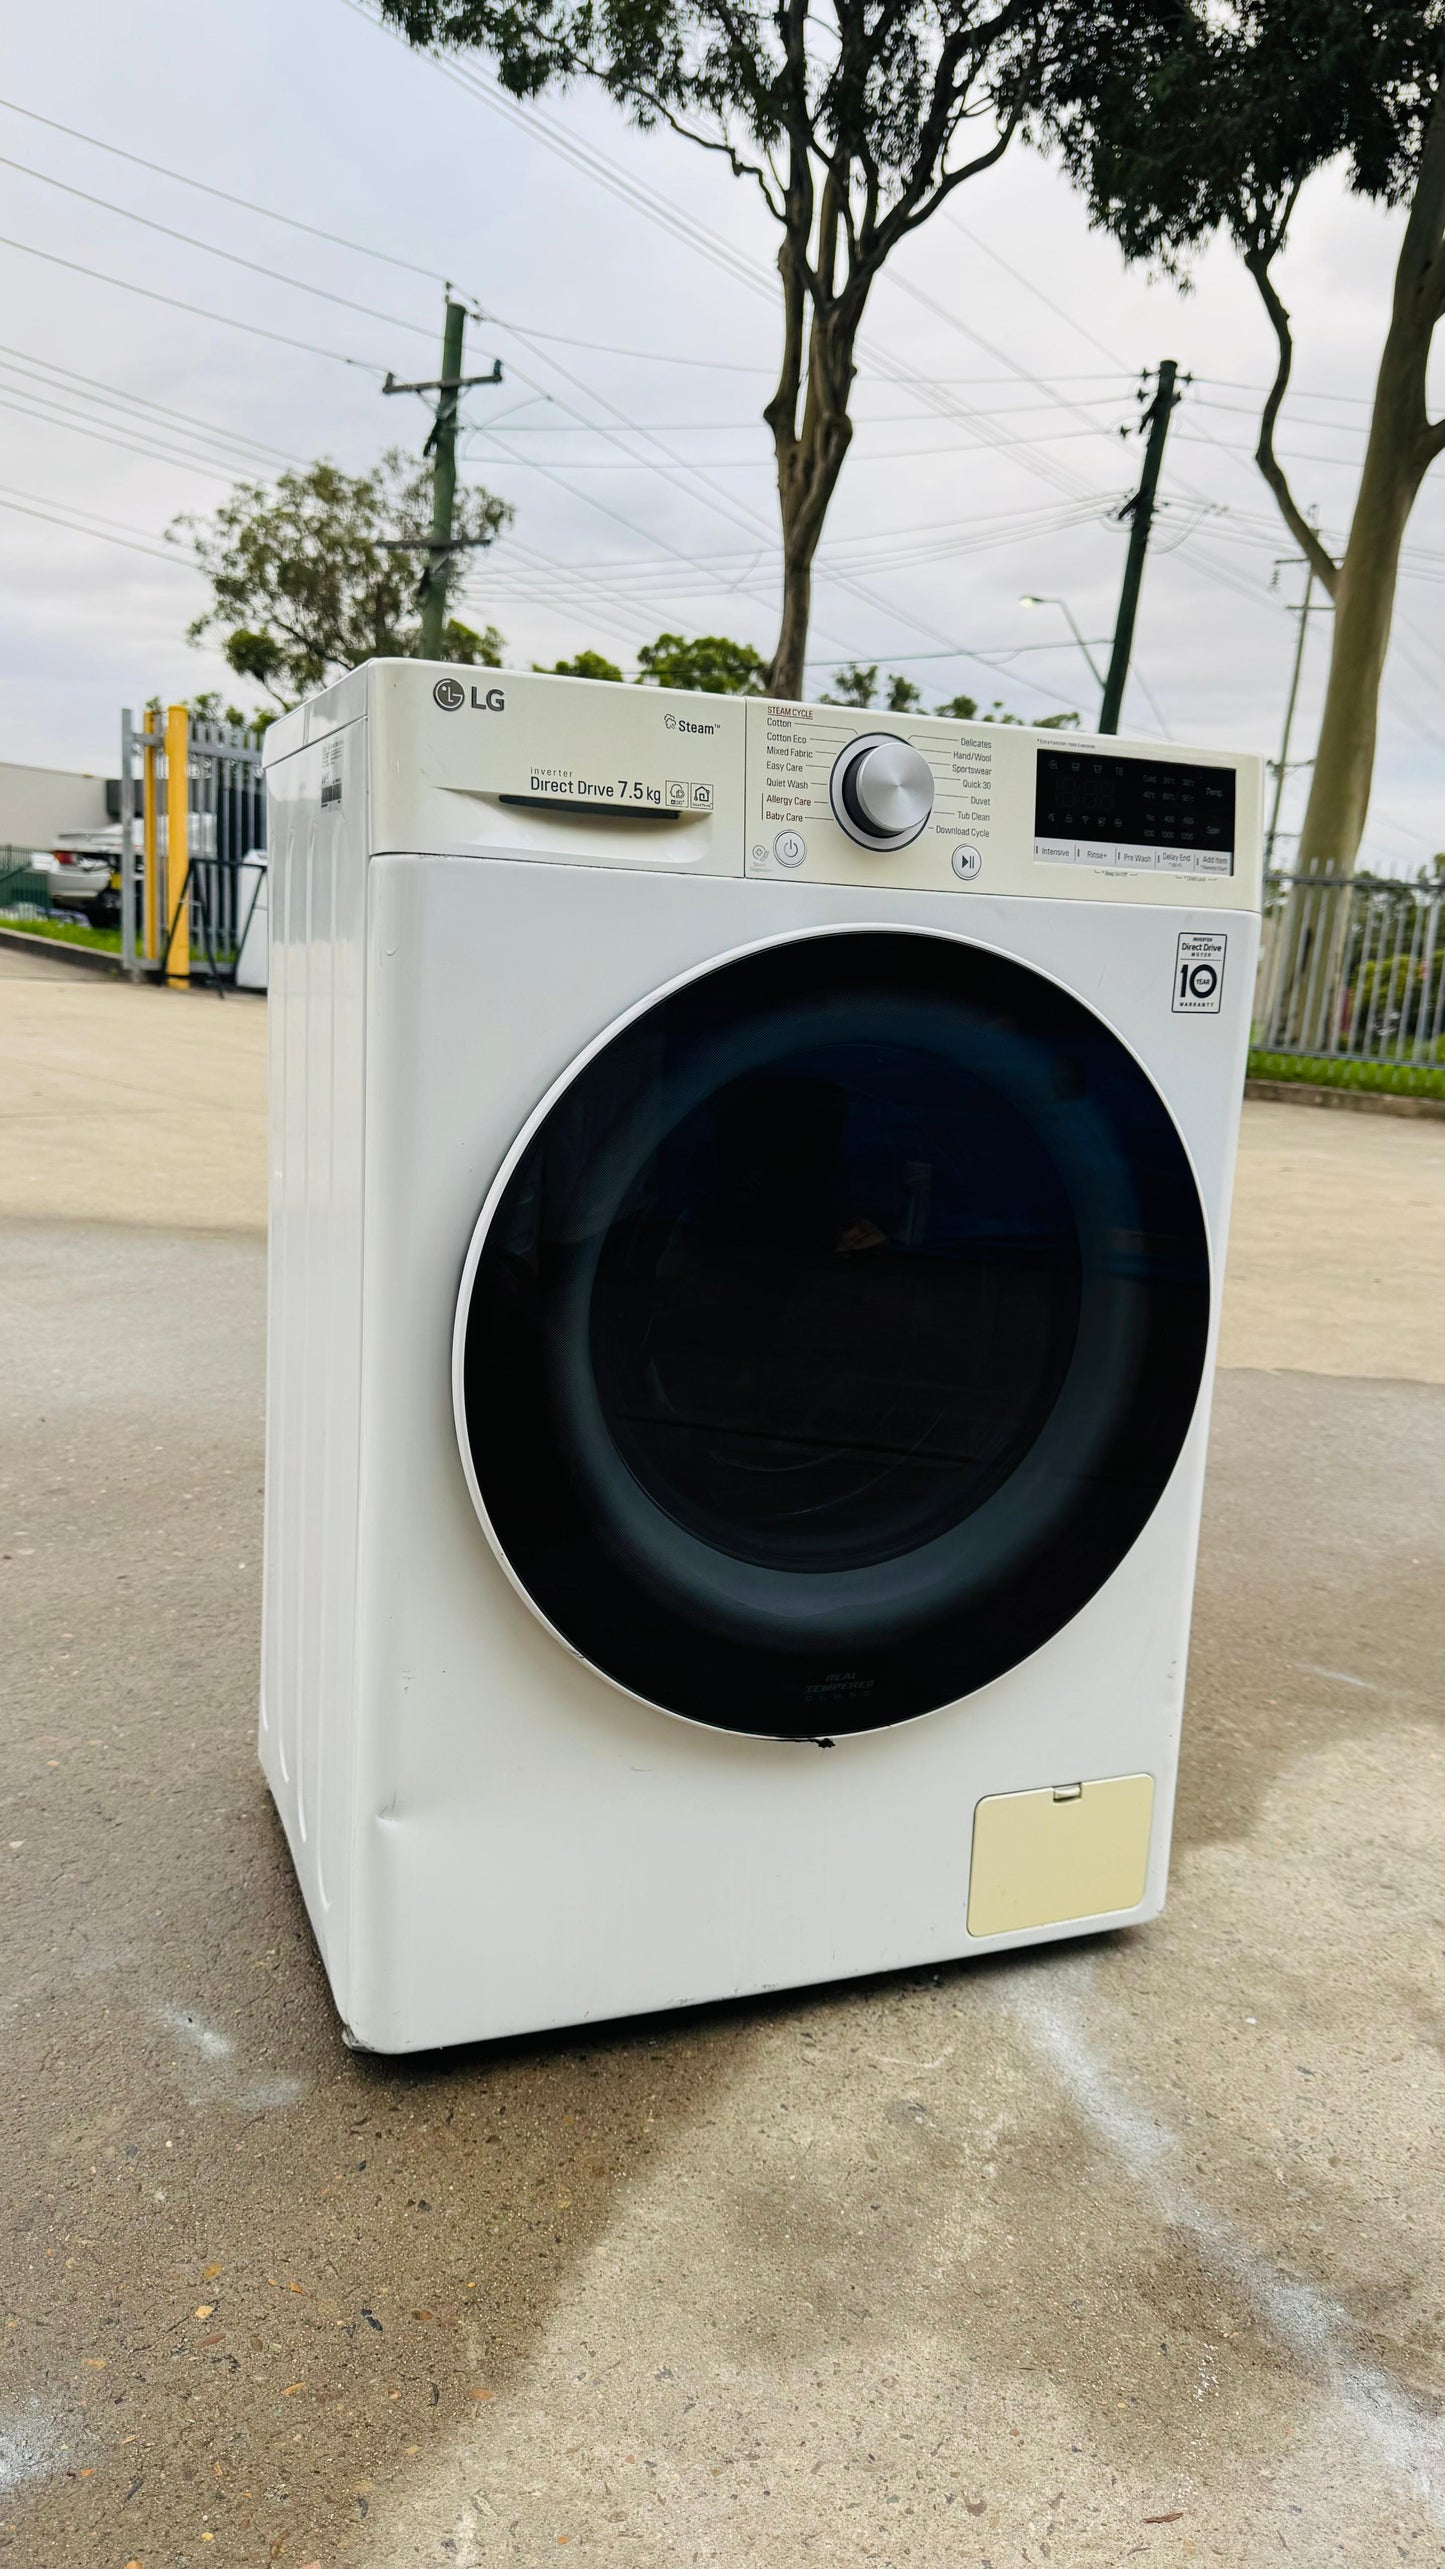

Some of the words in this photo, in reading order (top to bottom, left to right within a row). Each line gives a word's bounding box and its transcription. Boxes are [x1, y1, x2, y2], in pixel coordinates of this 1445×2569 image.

[471, 686, 504, 711] LG
[768, 706, 790, 716] STEAM
[791, 708, 813, 718] CYCLE
[767, 718, 791, 728] Cotton
[767, 733, 791, 742] Cotton
[793, 736, 806, 744] Eco
[961, 738, 991, 748] Delicates
[767, 746, 788, 756] Mixed
[791, 748, 813, 758] Fabric
[953, 752, 991, 762] Hand/Wool
[530, 766, 573, 777] inverter
[767, 762, 784, 772] Easy
[786, 764, 803, 772] Care
[952, 765, 992, 775] Sportswear
[767, 778, 785, 788] Quiet
[787, 780, 808, 789] Wash
[963, 780, 981, 789] Quick
[983, 782, 991, 790] 30
[531, 776, 573, 794] Direct
[578, 781, 614, 797] Drive
[618, 781, 643, 800] 7.5
[647, 786, 661, 804] kg
[767, 795, 792, 806] Allergy
[794, 797, 811, 806] Care
[971, 796, 990, 806] Duvet
[766, 811, 784, 822] Baby
[786, 813, 803, 822] Care
[958, 811, 970, 820] Tub
[971, 812, 990, 821] Clean
[936, 825, 970, 836] Download
[972, 828, 990, 838] Cycle
[1042, 848, 1069, 857] Intensive
[1163, 853, 1177, 862] Delay
[1179, 854, 1191, 862] End
[1124, 854, 1133, 862] Pre
[1134, 855, 1151, 863] Wash
[1203, 856, 1216, 864] Add
[1182, 943, 1202, 951] Direct
[1203, 944, 1222, 952] Drive
[1180, 964, 1218, 998] 10
